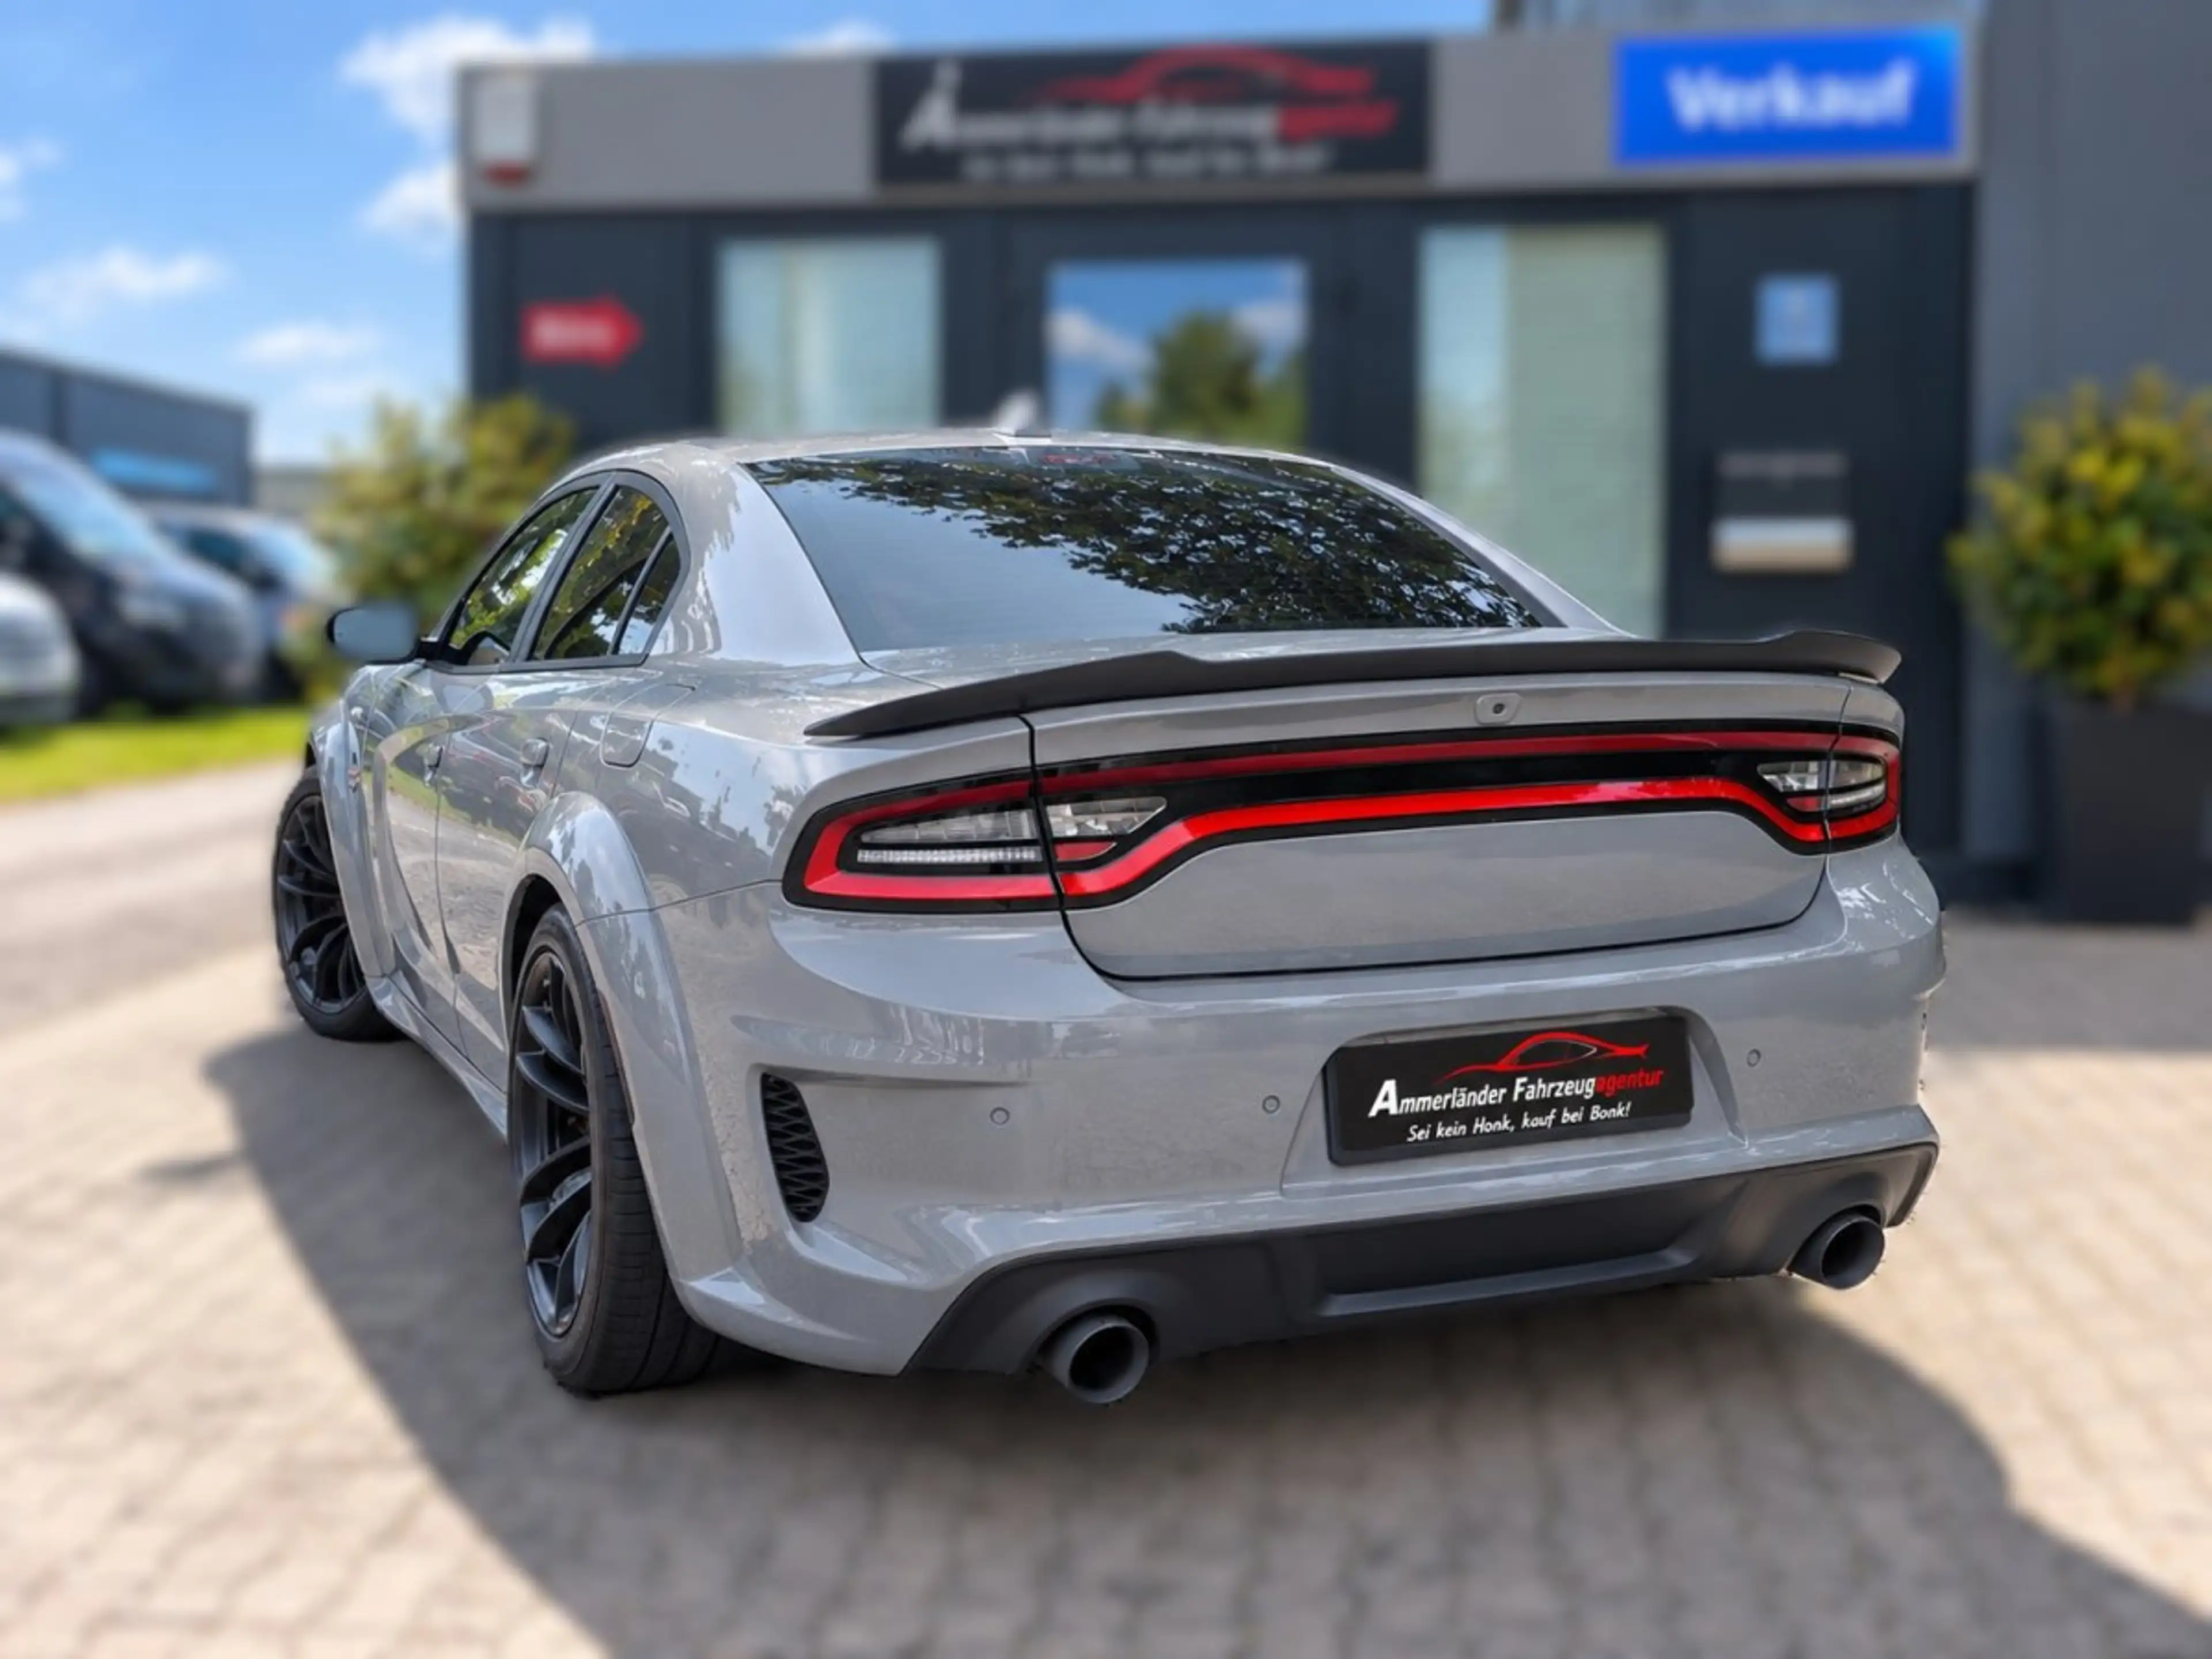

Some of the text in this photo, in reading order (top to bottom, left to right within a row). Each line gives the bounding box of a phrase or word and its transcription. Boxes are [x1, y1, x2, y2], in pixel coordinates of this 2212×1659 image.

[1368, 1078, 1507, 1118] Ammerländer
[1406, 1101, 1632, 1142] Sei kein Honk, kauf bei Bonk!
